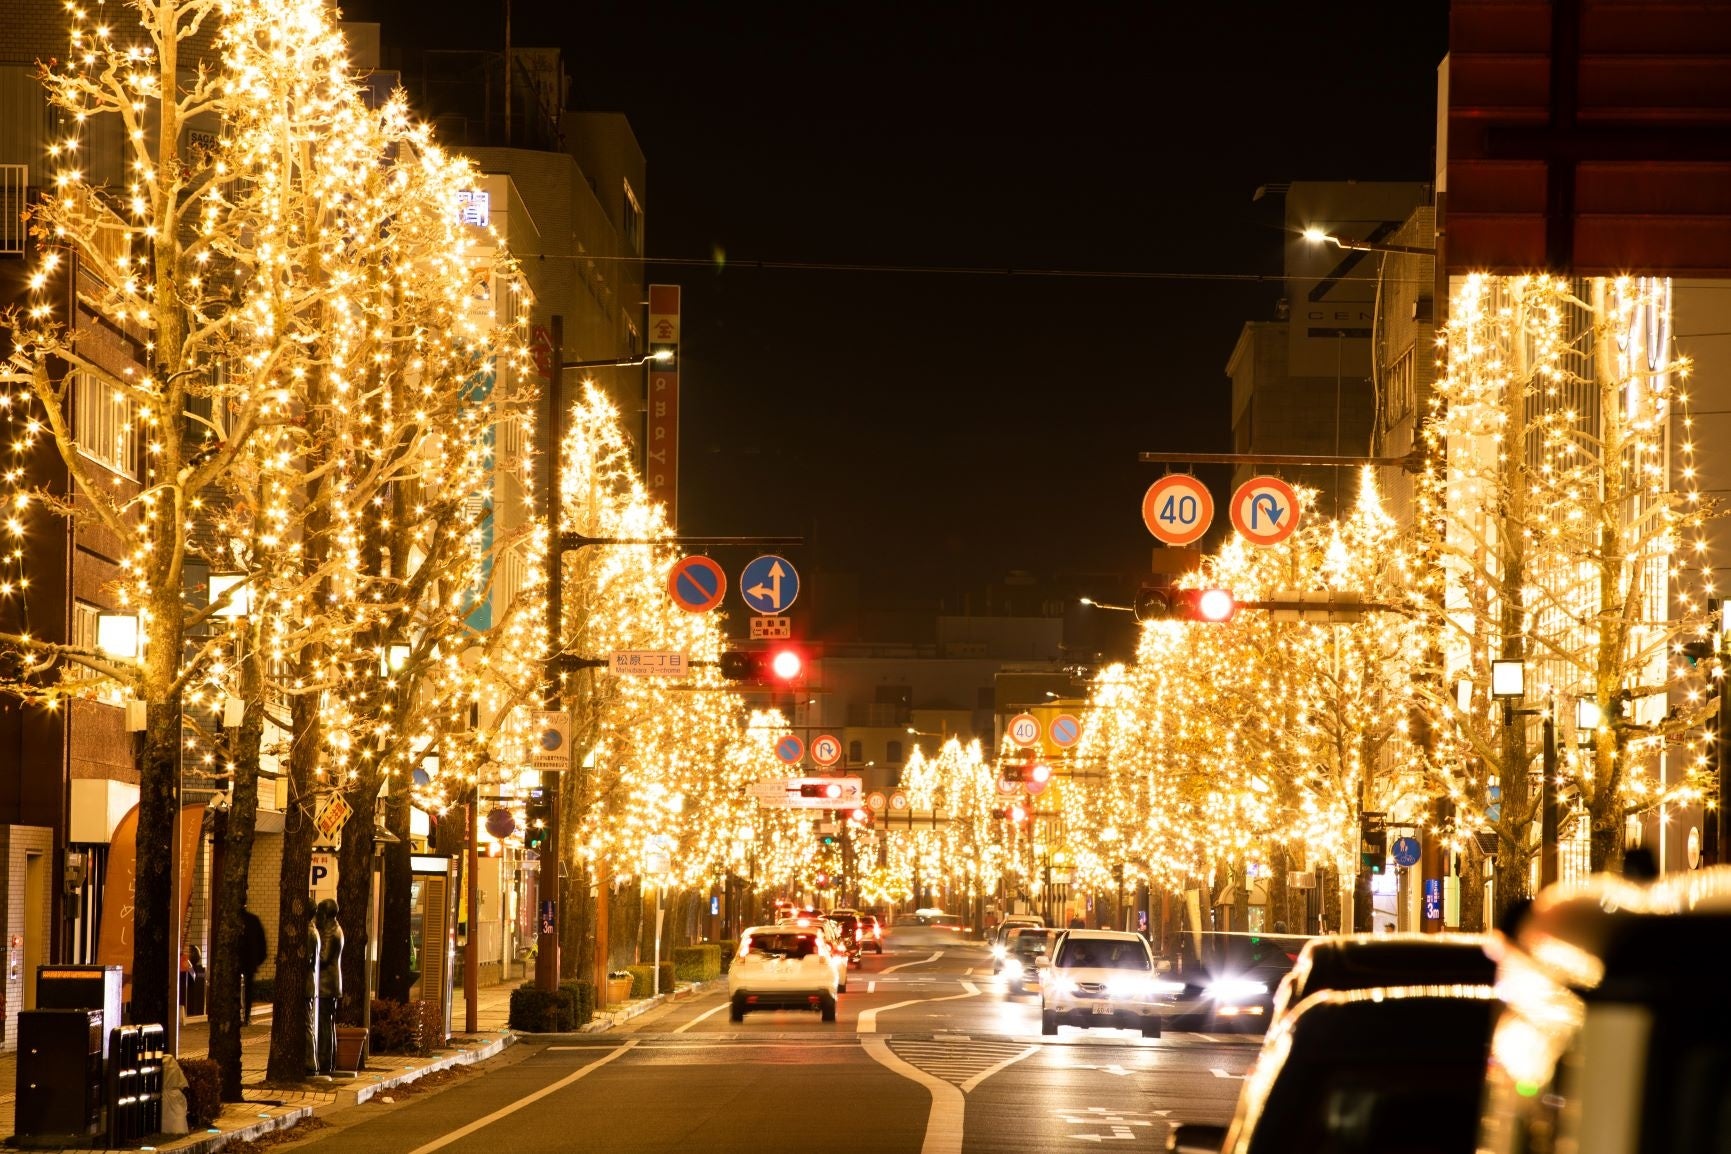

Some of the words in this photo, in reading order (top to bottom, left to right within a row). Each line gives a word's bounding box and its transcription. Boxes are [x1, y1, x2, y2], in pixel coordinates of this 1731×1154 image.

[1160, 495, 1197, 525] 40
[616, 654, 681, 666] 松原二丁目
[1016, 724, 1034, 738] 40
[312, 865, 328, 885] P
[1427, 902, 1440, 919] 3m
[542, 920, 554, 934] 3m
